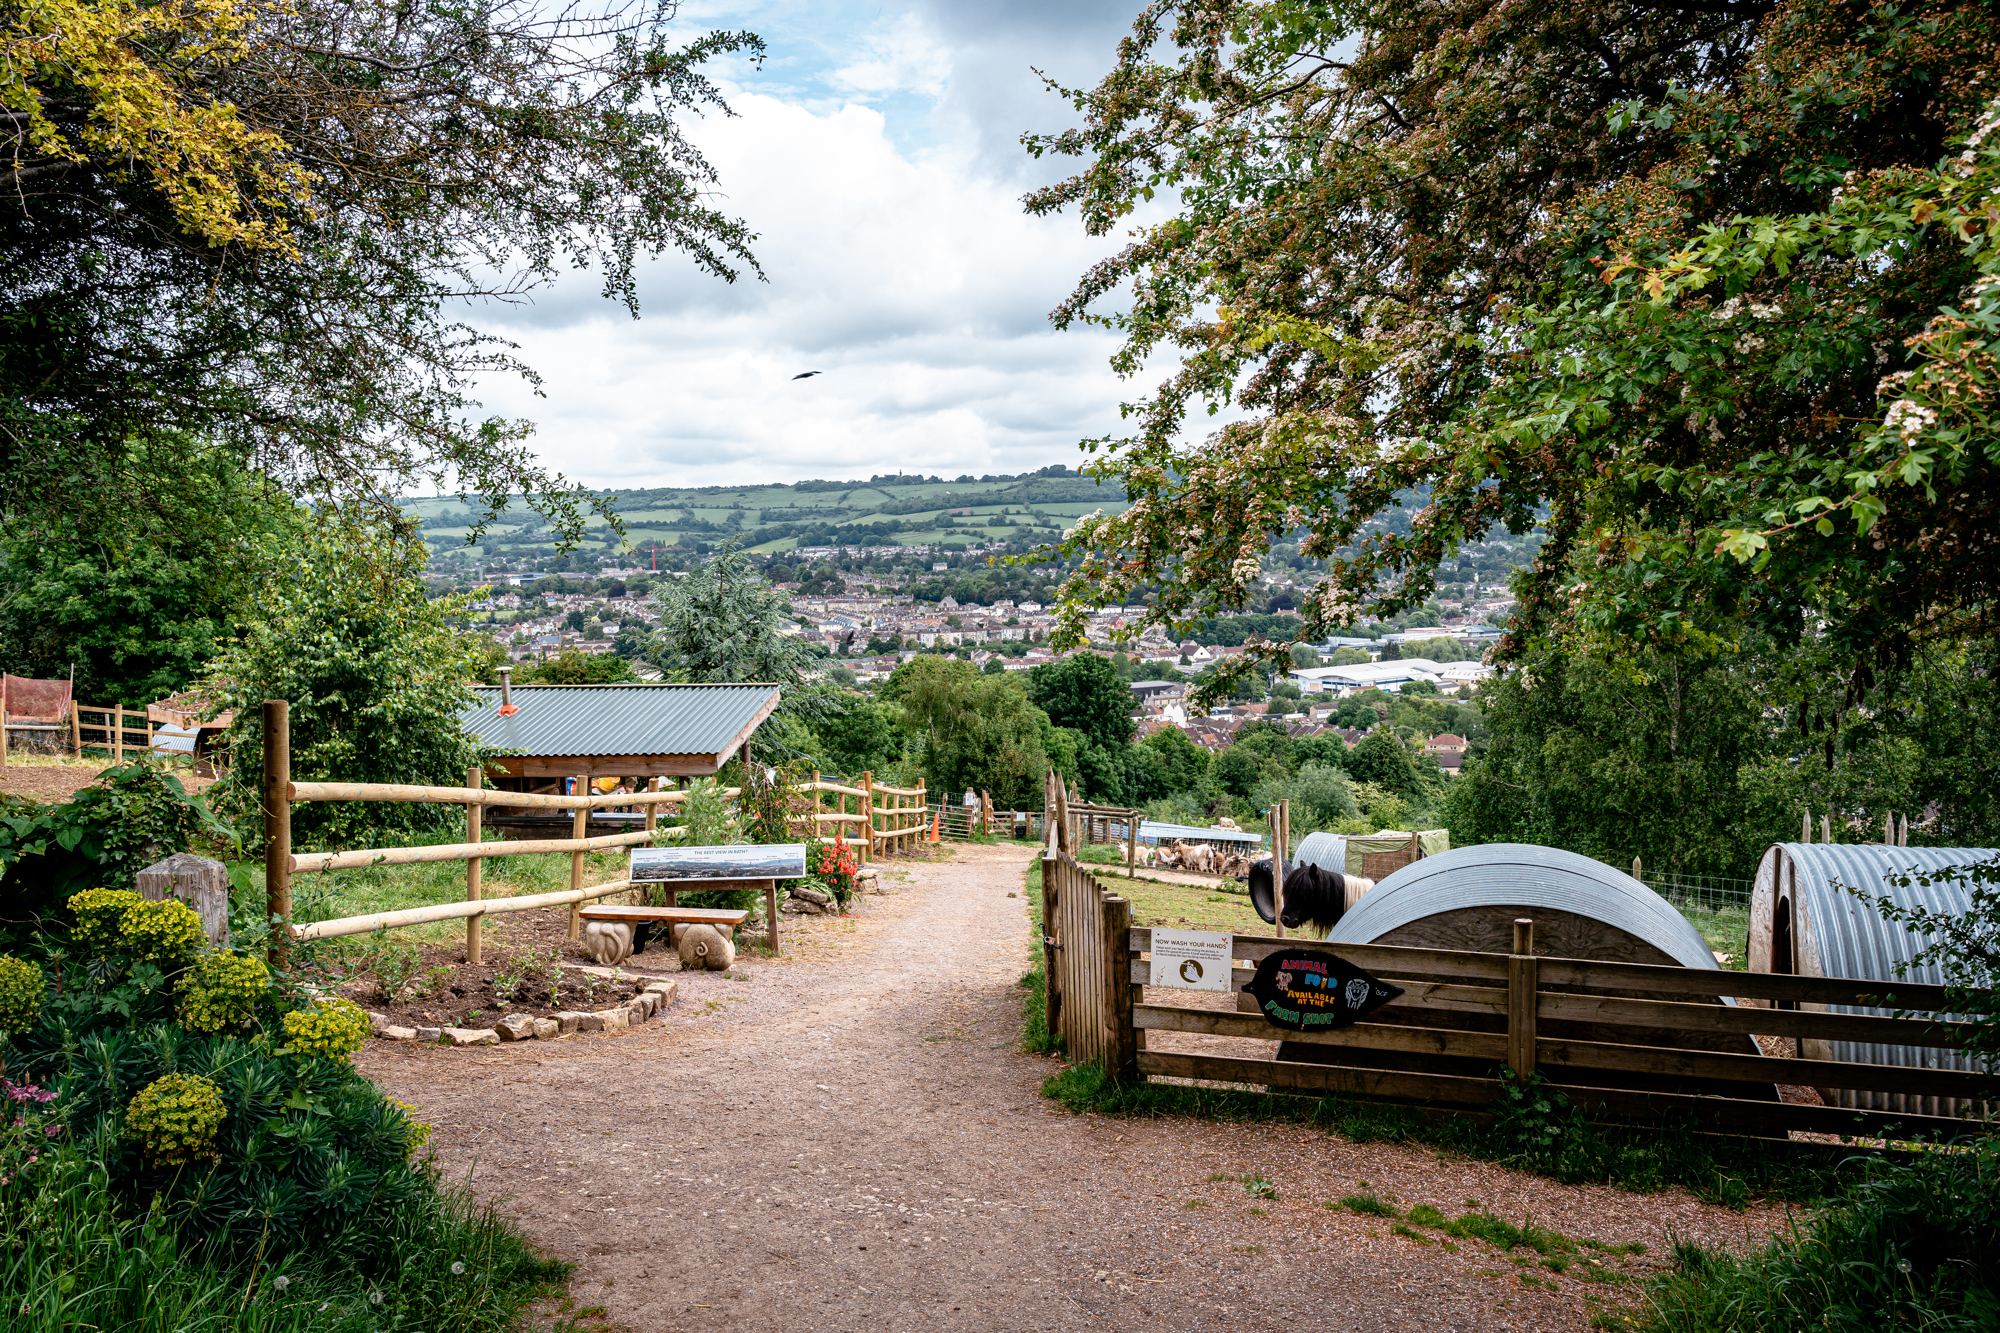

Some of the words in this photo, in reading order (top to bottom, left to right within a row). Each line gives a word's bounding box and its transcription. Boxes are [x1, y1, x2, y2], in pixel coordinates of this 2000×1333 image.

[1281, 959, 1328, 974] ANIMAL
[1287, 990, 1336, 1004] AVAILABLE
[1309, 999, 1325, 1007] THE
[1264, 1000, 1300, 1024] FARM
[1302, 1012, 1334, 1025] SHOP
